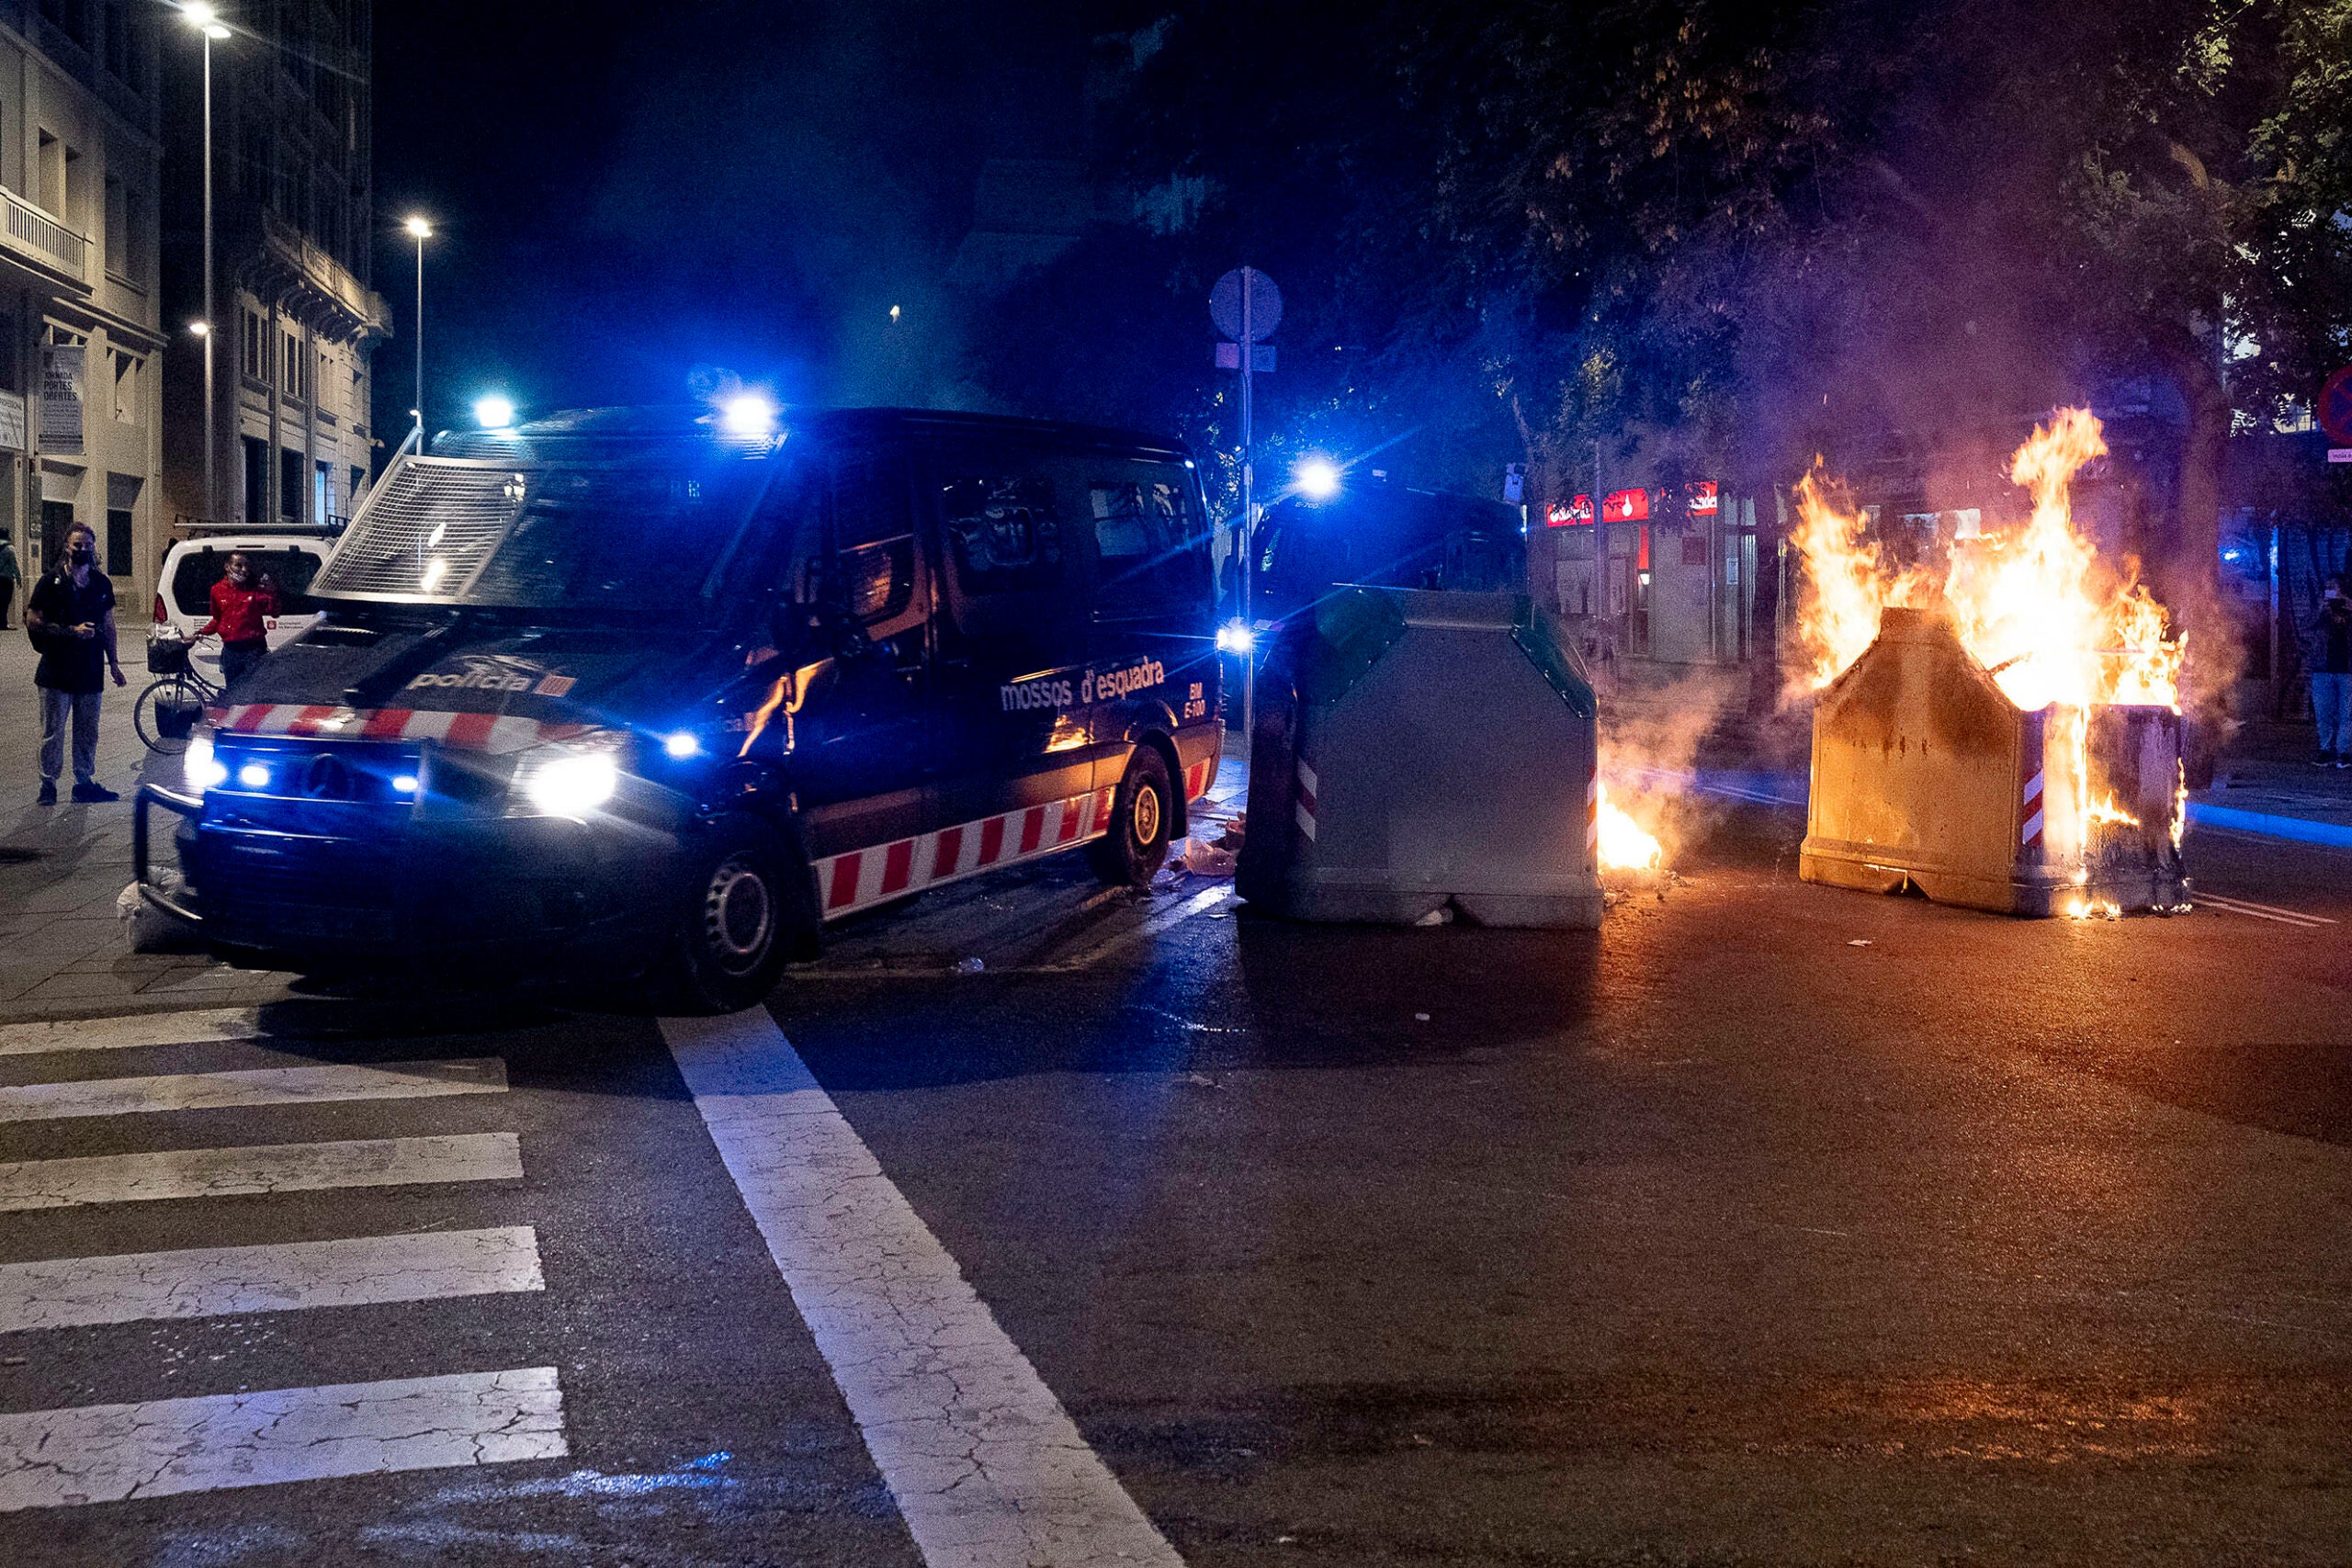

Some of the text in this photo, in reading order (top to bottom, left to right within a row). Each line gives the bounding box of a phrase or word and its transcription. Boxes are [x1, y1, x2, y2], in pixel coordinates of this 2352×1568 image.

[44, 381, 73, 390] PORTES
[44, 391, 77, 401] OBERTES
[404, 670, 533, 692] policia
[1000, 680, 1073, 711] mossos
